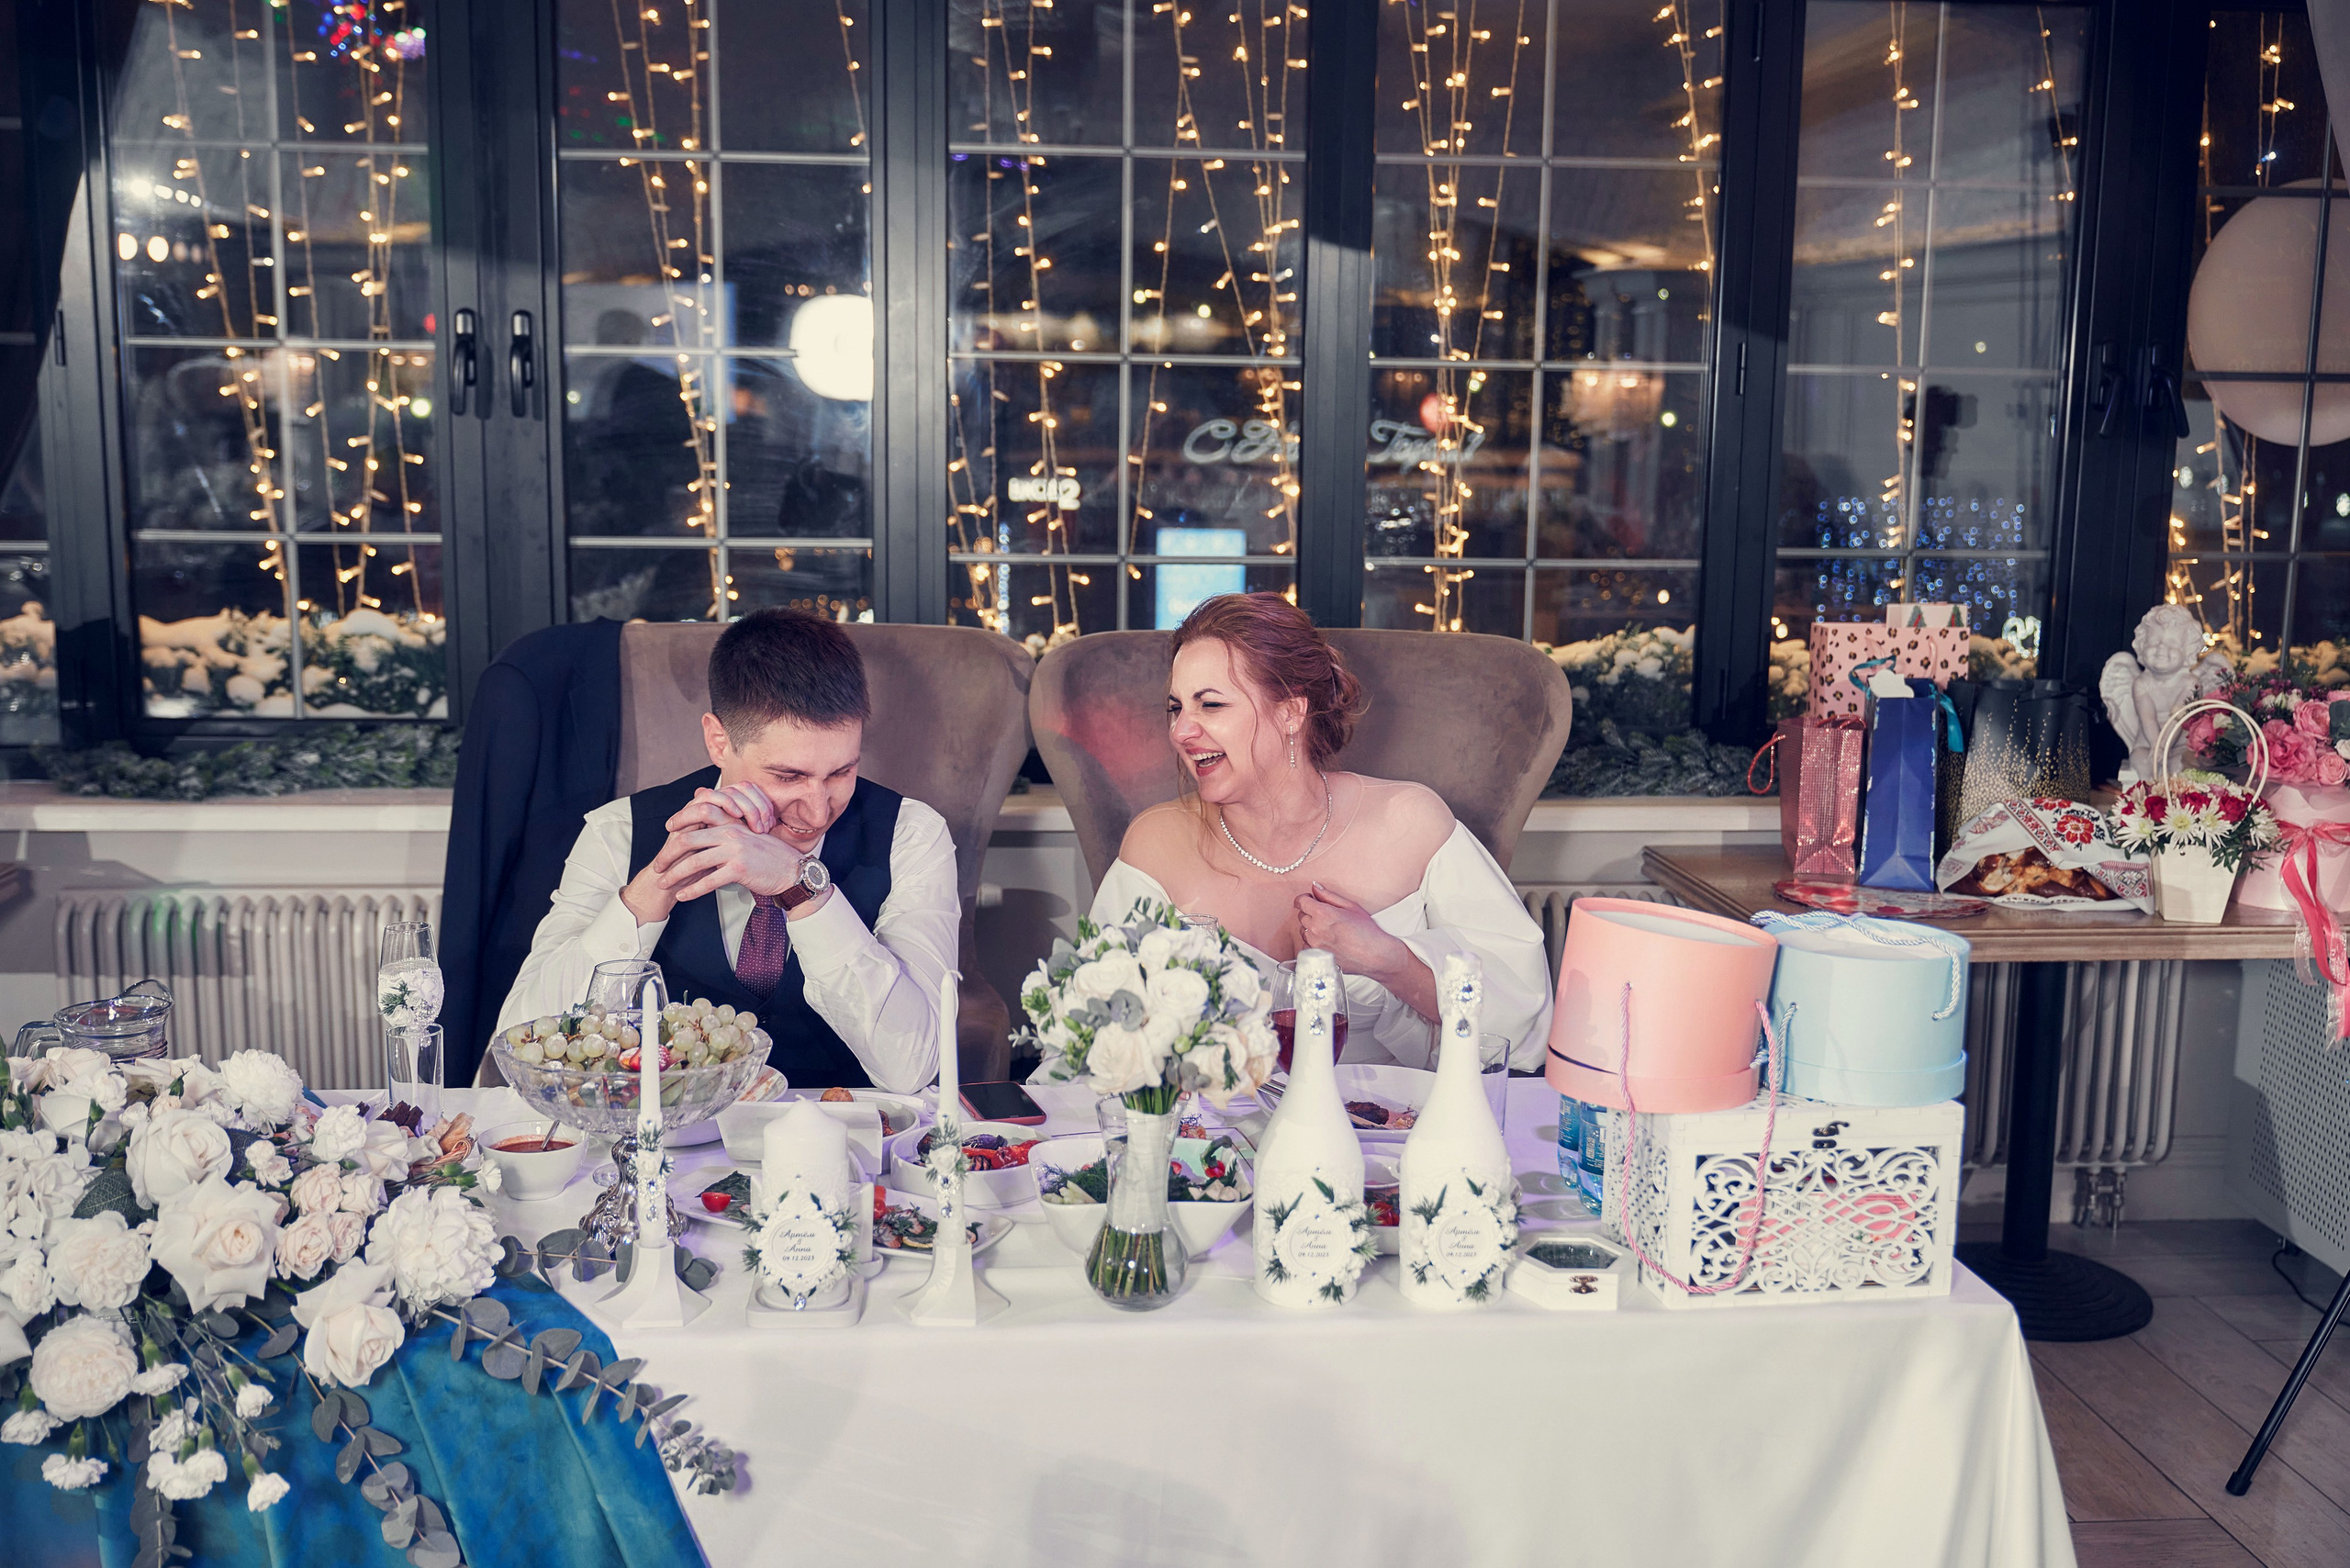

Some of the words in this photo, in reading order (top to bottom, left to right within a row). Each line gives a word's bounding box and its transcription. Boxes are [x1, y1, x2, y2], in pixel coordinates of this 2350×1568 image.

[779, 1229, 816, 1240] Артём
[784, 1244, 811, 1252] Анна
[1300, 1240, 1327, 1249] Анна
[1448, 1240, 1475, 1249] Анна
